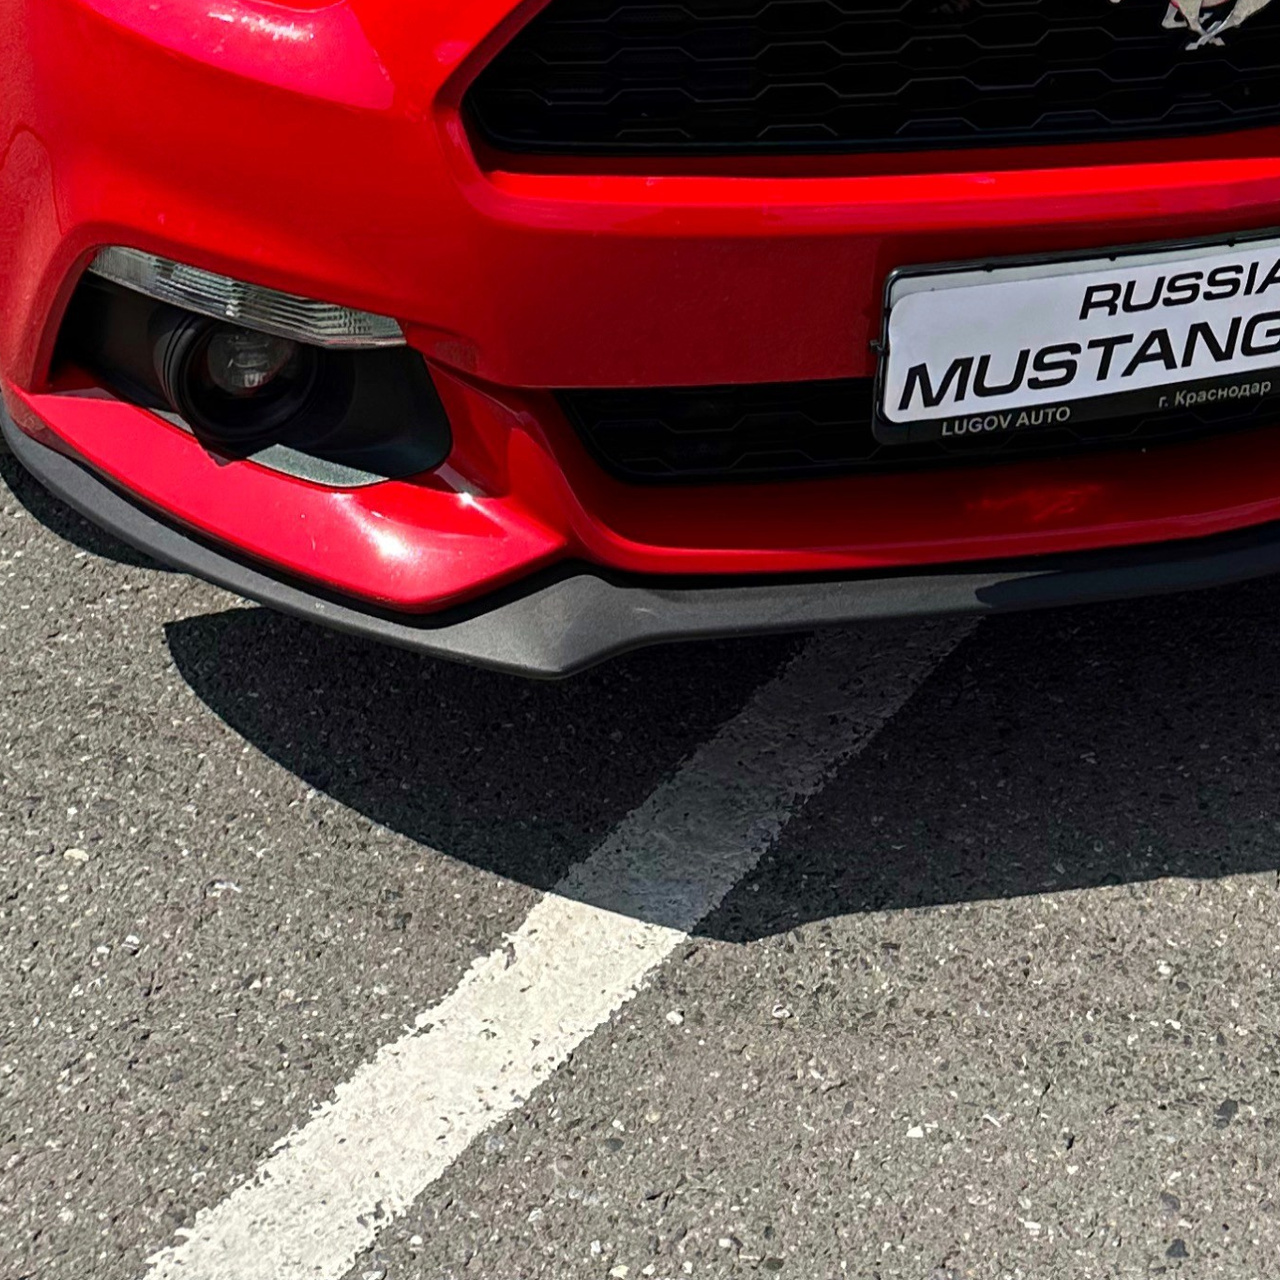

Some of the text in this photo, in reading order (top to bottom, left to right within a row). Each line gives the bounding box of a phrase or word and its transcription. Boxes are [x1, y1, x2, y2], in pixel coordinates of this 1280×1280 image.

[1158, 380, 1272, 408] г. Краснодар
[942, 407, 1071, 436] LUGOV AUTO
